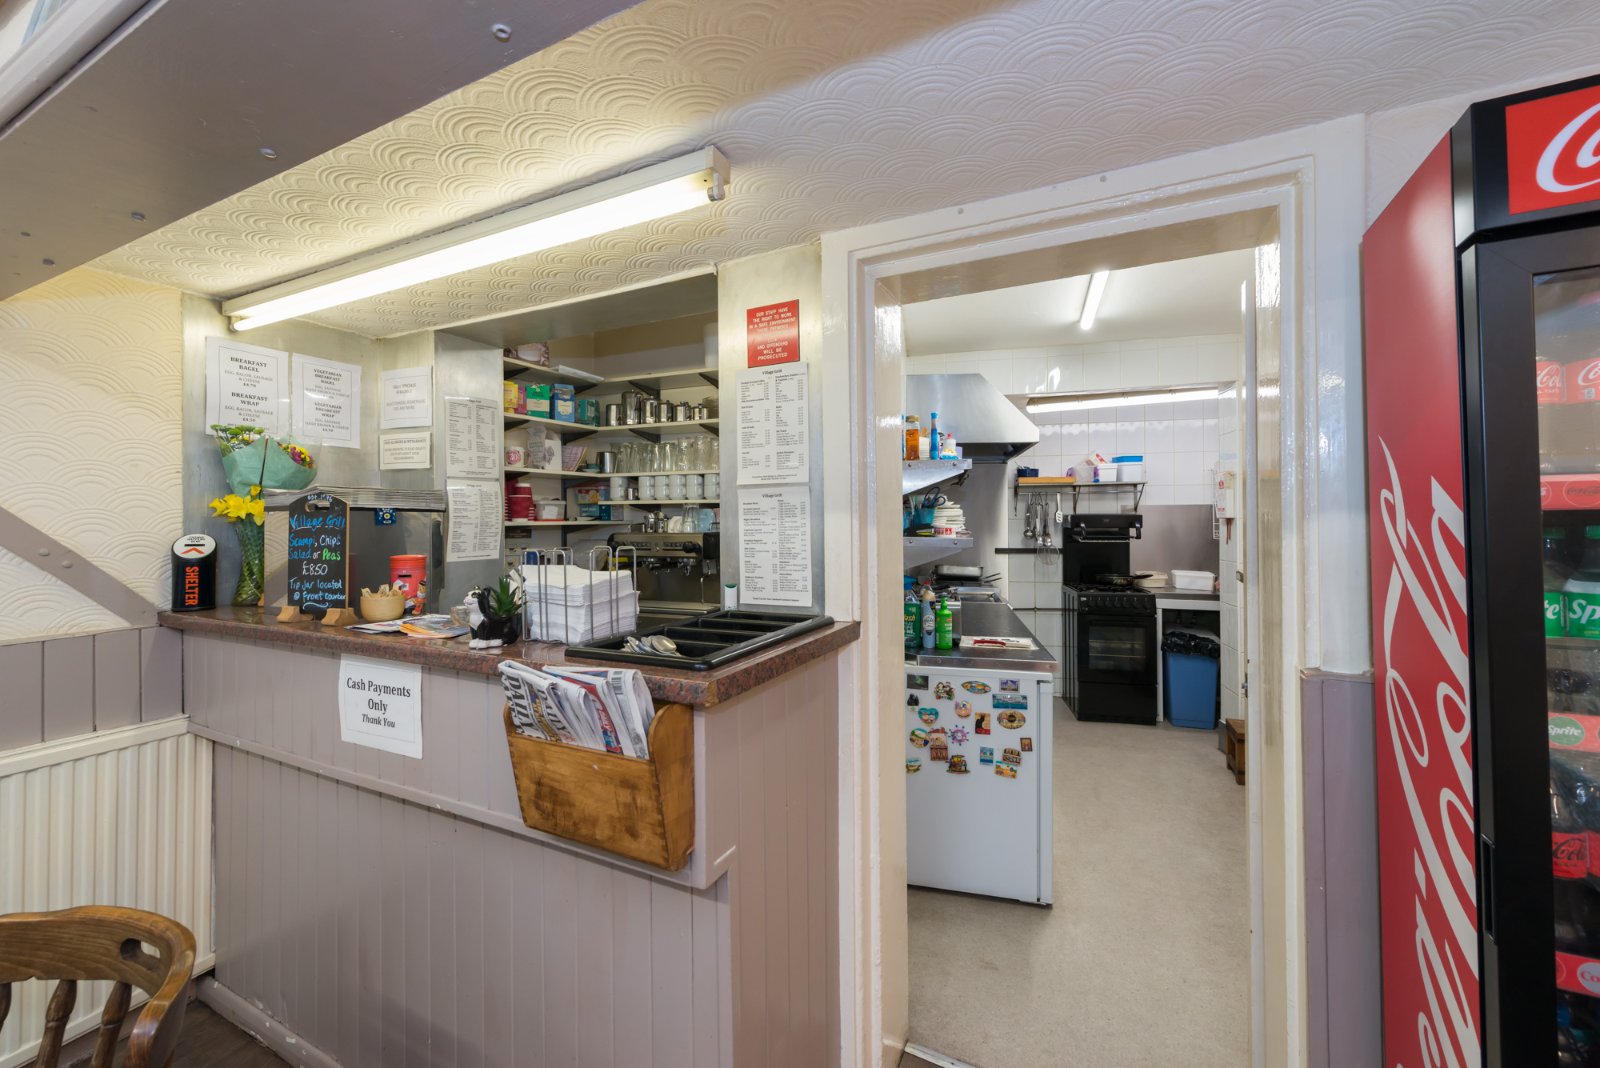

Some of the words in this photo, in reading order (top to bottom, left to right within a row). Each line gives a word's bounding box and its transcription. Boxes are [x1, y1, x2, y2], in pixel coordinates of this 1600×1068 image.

[230, 356, 267, 368] BREAKFAST
[239, 364, 260, 373] BAGEL
[231, 392, 268, 402] BREAKFAST
[290, 514, 322, 532] Village
[326, 514, 345, 528] Grill
[320, 535, 340, 548] Chips
[288, 548, 311, 559] Salad
[313, 551, 320, 559] or
[322, 548, 341, 560] Peas
[185, 566, 199, 606] SHELTER
[290, 577, 300, 590] Tip
[317, 579, 342, 589] located
[347, 677, 365, 691] Cash
[368, 680, 411, 697] Payments
[368, 698, 388, 715] Only
[507, 675, 535, 731] DAILY
[362, 714, 382, 726] Thank
[383, 718, 395, 728] You
